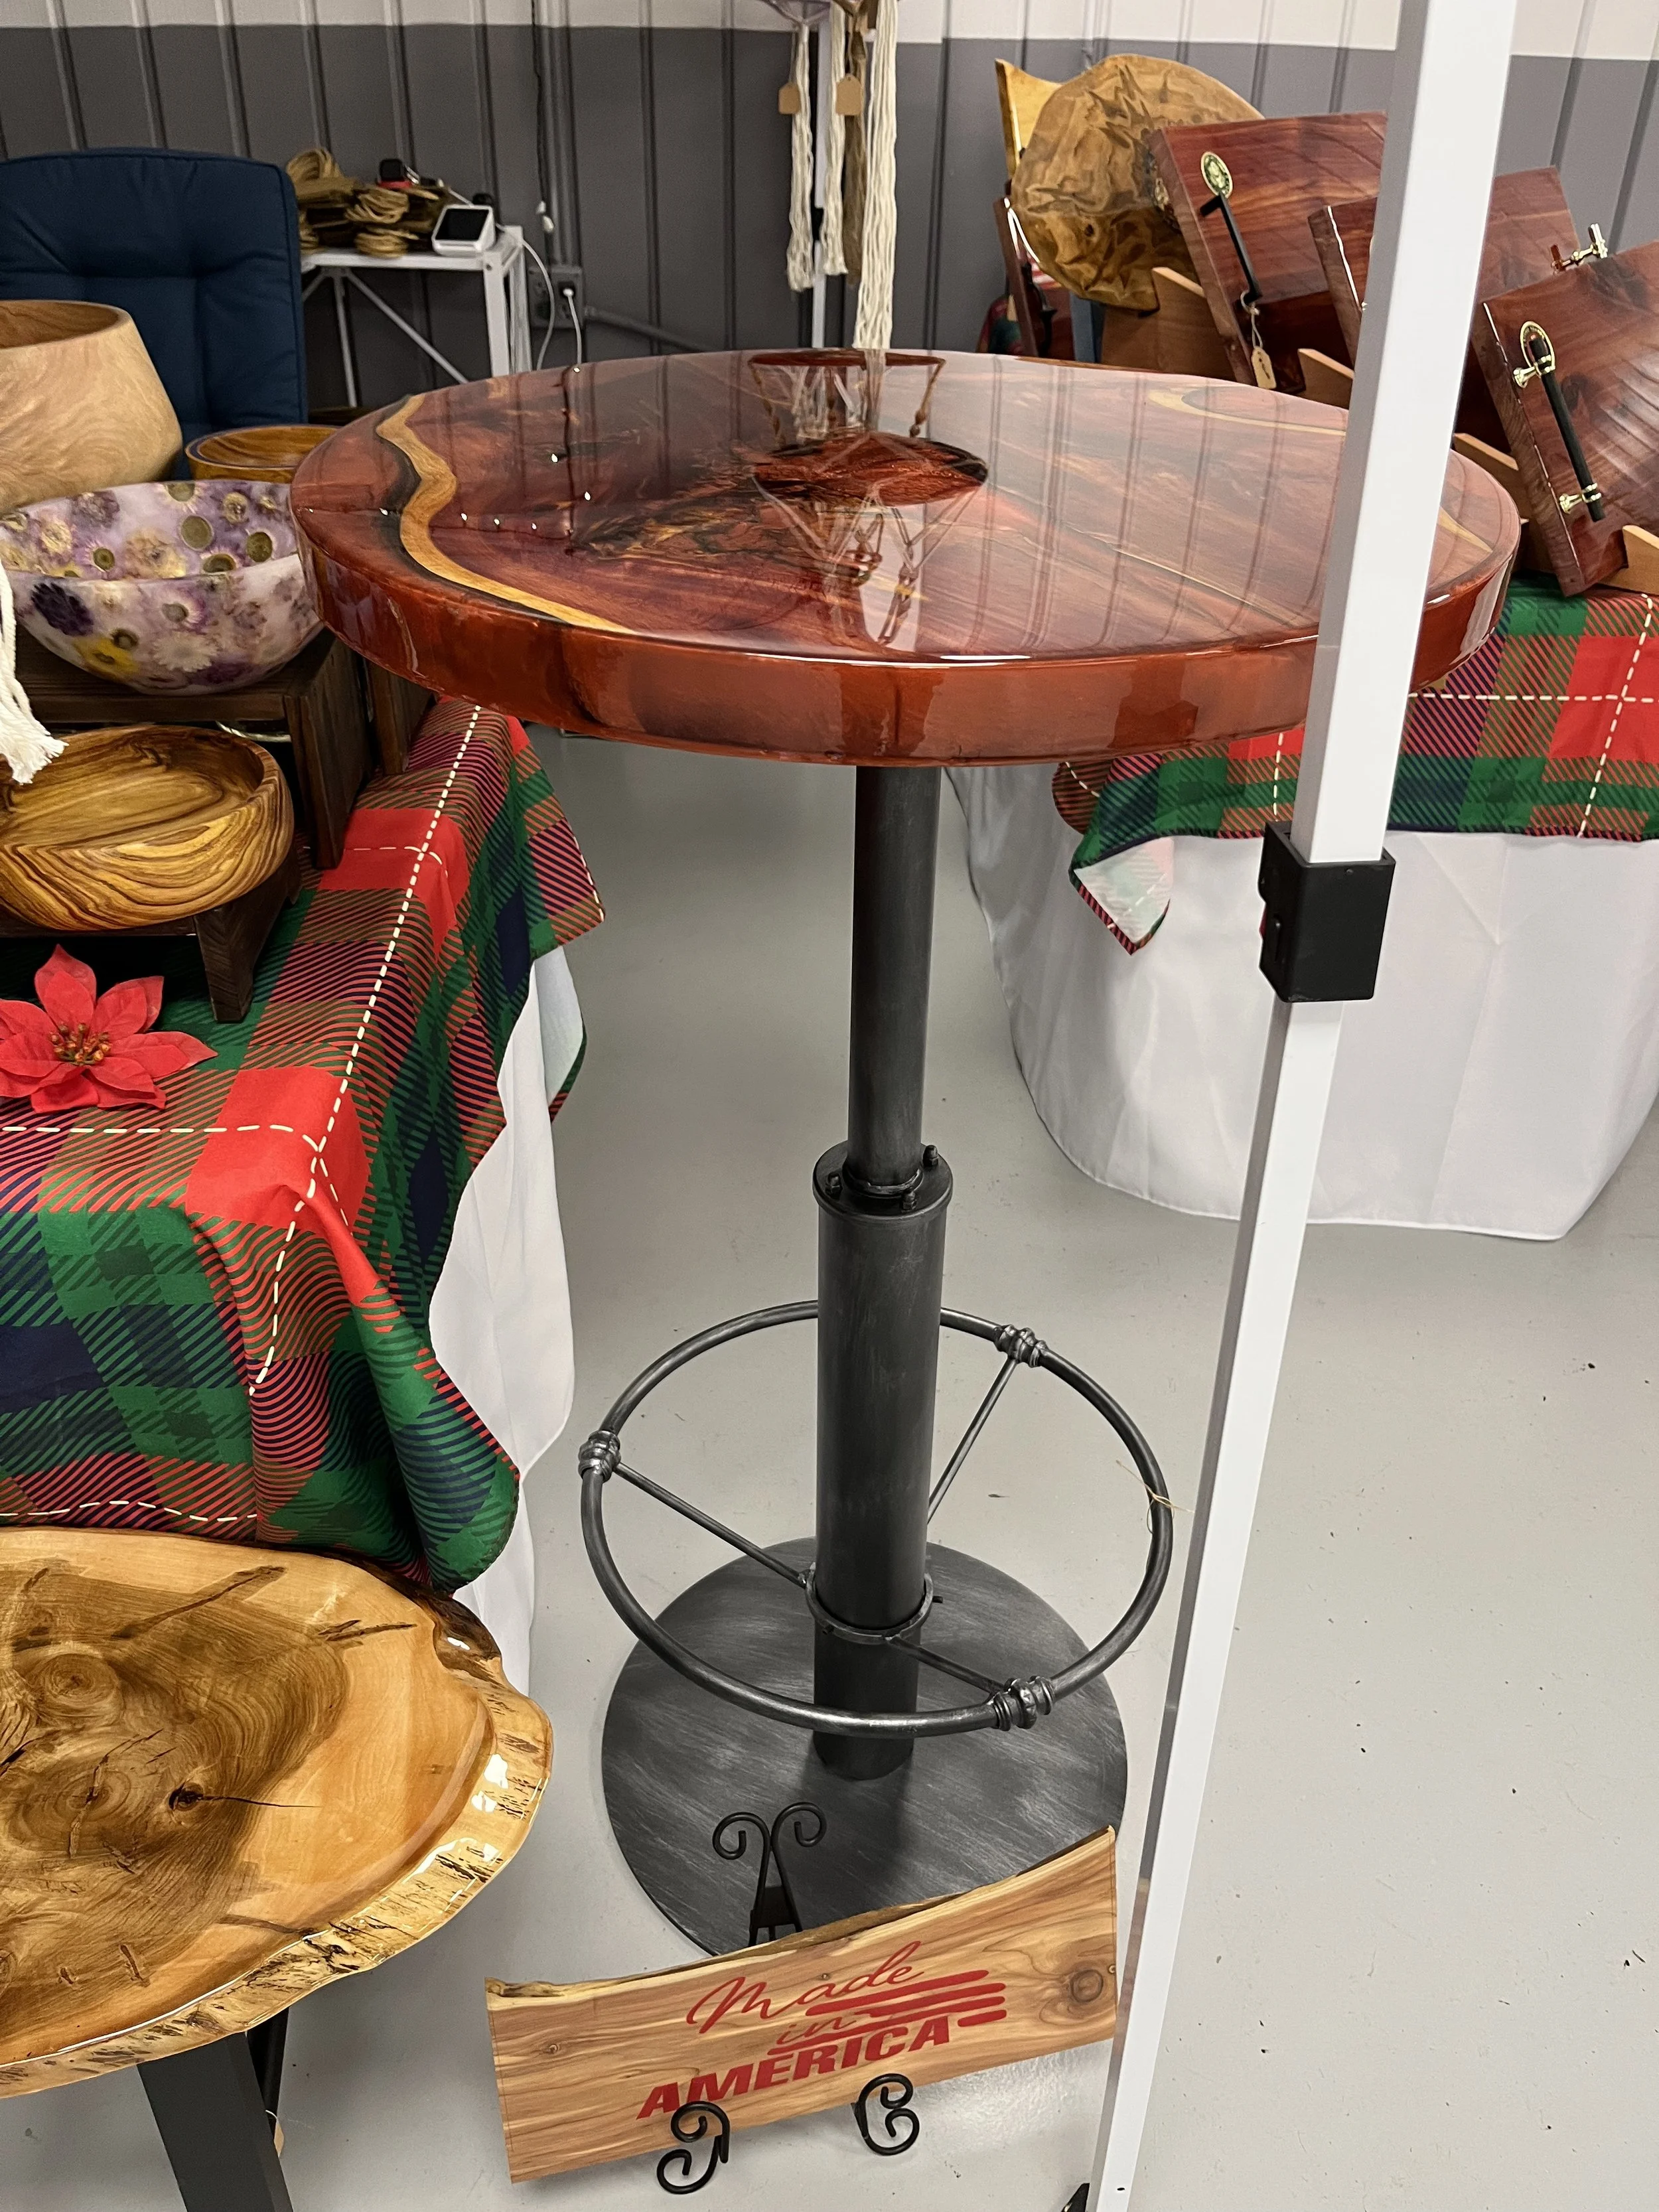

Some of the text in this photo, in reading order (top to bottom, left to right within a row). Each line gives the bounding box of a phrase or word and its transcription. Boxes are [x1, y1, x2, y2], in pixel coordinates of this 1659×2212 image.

[686, 1941, 924, 2033] Made
[776, 2016, 857, 2045] in
[636, 2016, 950, 2119] AMERICA
